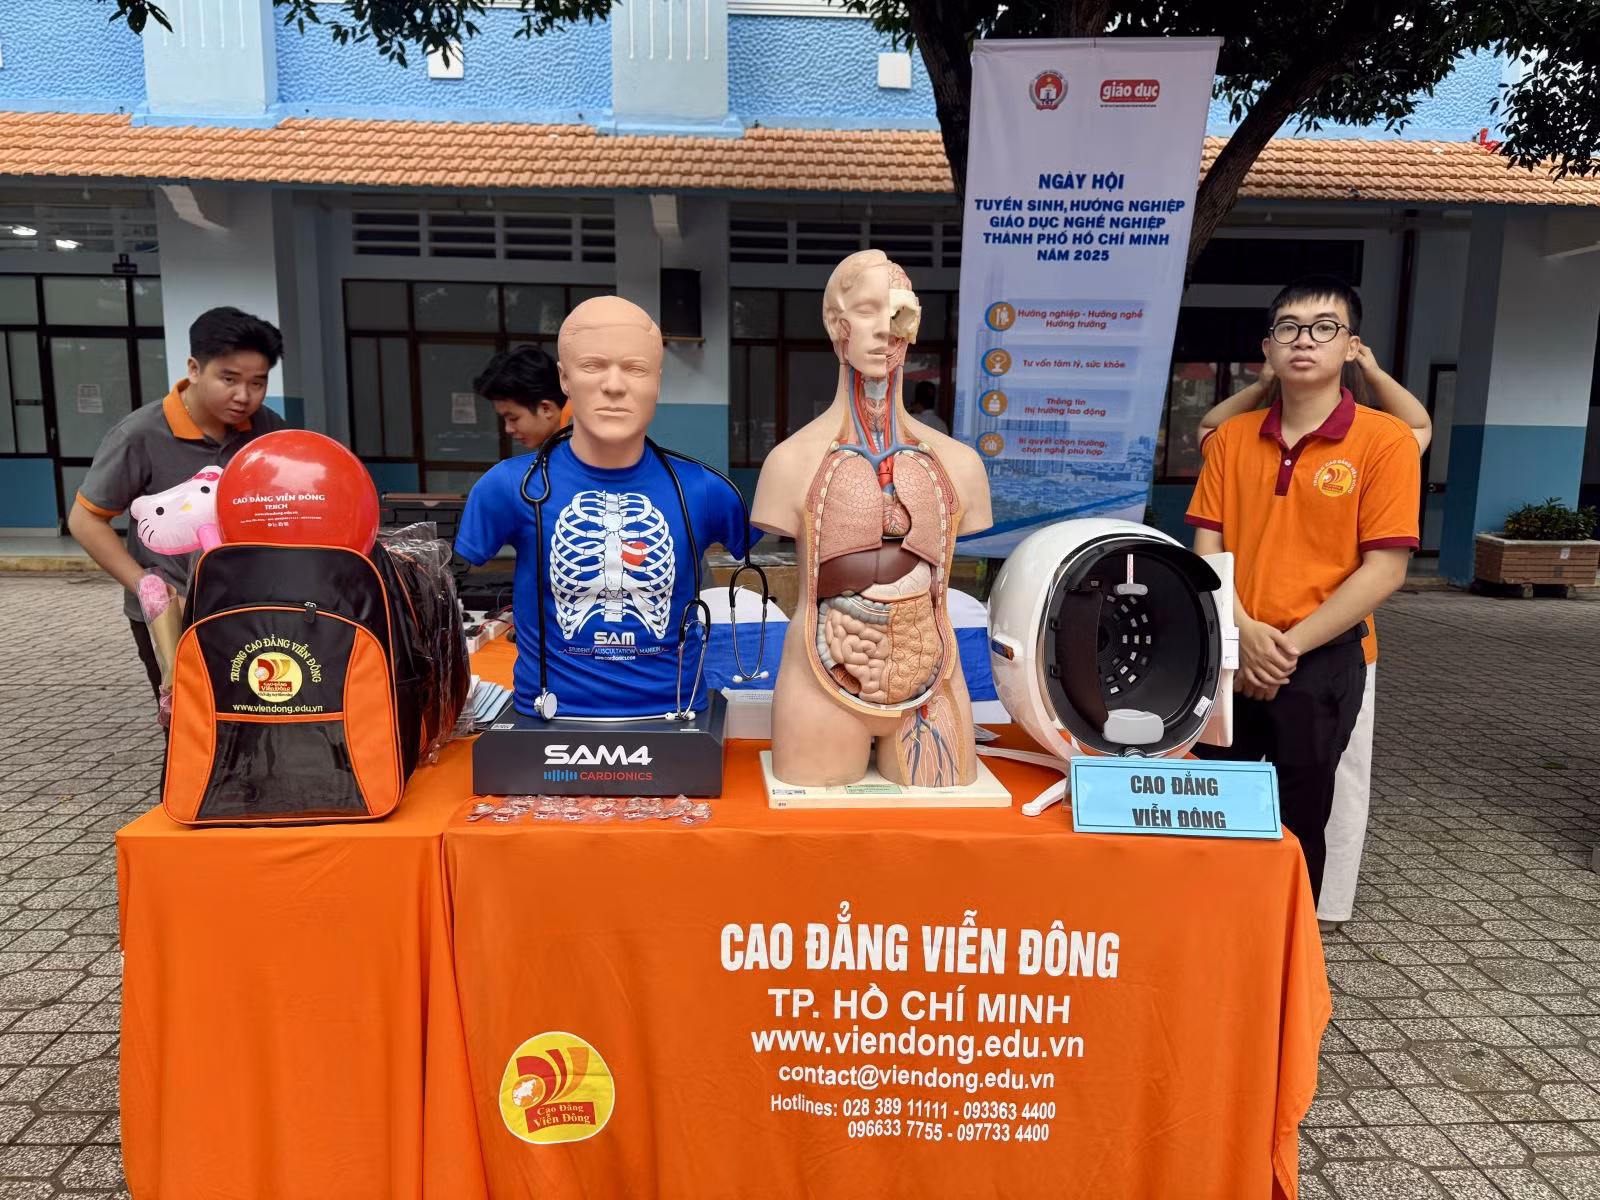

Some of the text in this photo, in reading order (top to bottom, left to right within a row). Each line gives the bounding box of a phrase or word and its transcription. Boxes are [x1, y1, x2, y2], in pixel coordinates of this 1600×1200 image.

[1102, 81, 1158, 101] giáo dục
[1038, 170, 1124, 192] NGÀY HỘI
[1027, 199, 1067, 214] SINH,
[1128, 198, 1186, 214] NGHIỆP
[989, 213, 1025, 228] GIÁO
[1028, 216, 1059, 231] DỤC
[1109, 215, 1166, 231] NGHIỆP
[983, 230, 1033, 244] THÀNH
[1037, 230, 1068, 245] PHỐ
[1098, 231, 1125, 245] CHÍ
[1129, 233, 1170, 246] MINH
[1037, 247, 1110, 261] NĂM 2025
[232, 495, 248, 505] CAO
[298, 492, 326, 502] ĐÔNG
[594, 632, 635, 645] SAM
[230, 650, 248, 683] TRƯỜNG
[244, 639, 263, 653] CAO
[263, 633, 291, 649] ĐẲNG
[306, 657, 322, 683] ĐÔNG
[232, 704, 323, 714] www.viendong.edu.vn
[543, 744, 654, 766] SAM4
[580, 771, 653, 781] CARDIONICS
[1130, 770, 1219, 796] CAO ĐẲNG
[1132, 803, 1227, 829] VIỄN ĐÔNG
[720, 900, 1120, 979] CAO ĐẲNG VIỄN ĐÔNG
[767, 982, 1071, 1024] TP. HỒ CHÍ MINH
[751, 1024, 1084, 1065] www.viendong.edu.vn
[778, 1064, 1055, 1094] contact@viendong.edu.vn
[536, 1105, 557, 1117] Cao
[770, 1093, 838, 1117] Hotlines:
[842, 1098, 870, 1117] 028
[874, 1097, 902, 1116] 389
[907, 1098, 948, 1120] 11111
[963, 1101, 1017, 1120] 093363
[1021, 1101, 1056, 1120] 4400
[562, 1113, 590, 1124] Đông
[847, 1118, 901, 1138] 096633
[906, 1119, 943, 1141] 7755
[957, 1122, 1010, 1142] 097733
[1014, 1123, 1050, 1142] 4400
